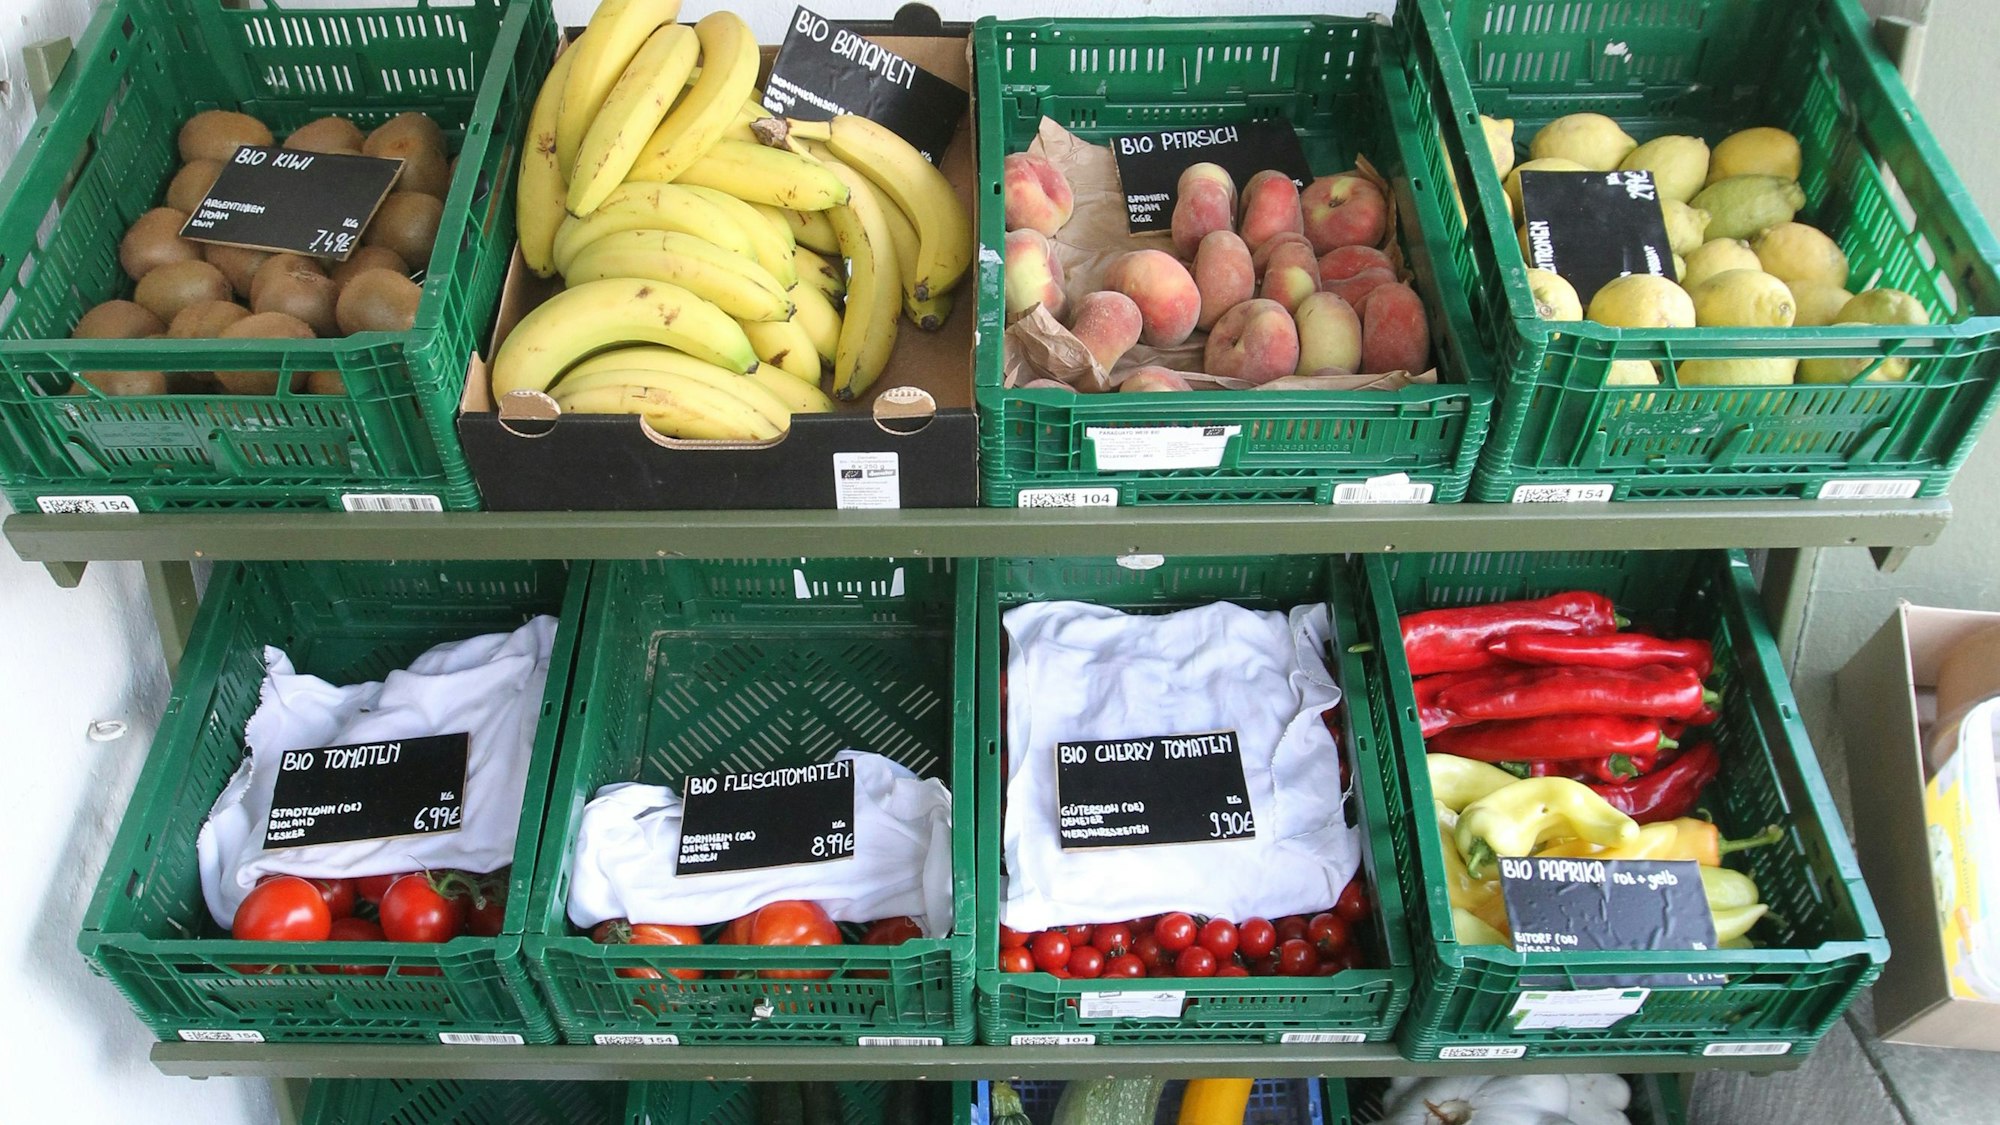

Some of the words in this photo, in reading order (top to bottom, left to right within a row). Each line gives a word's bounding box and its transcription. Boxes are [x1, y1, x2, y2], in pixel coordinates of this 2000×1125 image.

[795, 10, 829, 42] BIO
[830, 30, 916, 89] BANANEN
[1120, 136, 1153, 155] BIO
[1161, 126, 1238, 150] PFIRSICH
[235, 148, 267, 166] BIO
[272, 153, 314, 170] KIWI
[1128, 203, 1160, 213] IFOAM
[199, 209, 229, 220] IFOAM
[343, 218, 359, 229] KG
[1082, 494, 1110, 503] 104
[1577, 489, 1604, 498] 154
[100, 500, 129, 510] 154
[1061, 746, 1087, 764] BIO
[1095, 742, 1154, 762] CHERRY
[1161, 735, 1232, 759] TOMATEN
[282, 752, 314, 771] BIO
[324, 743, 401, 768] TOMATEN
[690, 778, 717, 795] BIO
[724, 761, 849, 791] FLEISCHTOMATEN
[441, 792, 454, 801] KG
[271, 805, 336, 818] STADTLOHN
[338, 802, 362, 812] (DE)
[1061, 803, 1119, 816] GÜTERSLOH
[1122, 802, 1145, 813] (DE)
[269, 817, 315, 830] BIOLAND
[1061, 815, 1104, 827] DEMETER
[268, 828, 305, 840] LESKER
[682, 833, 732, 844] BORNHEIM
[682, 842, 730, 853] DEMETER
[1502, 860, 1532, 880] BIO
[1538, 859, 1606, 883] PAPRIKA
[1613, 872, 1636, 886] rot
[1648, 870, 1678, 891] gelb
